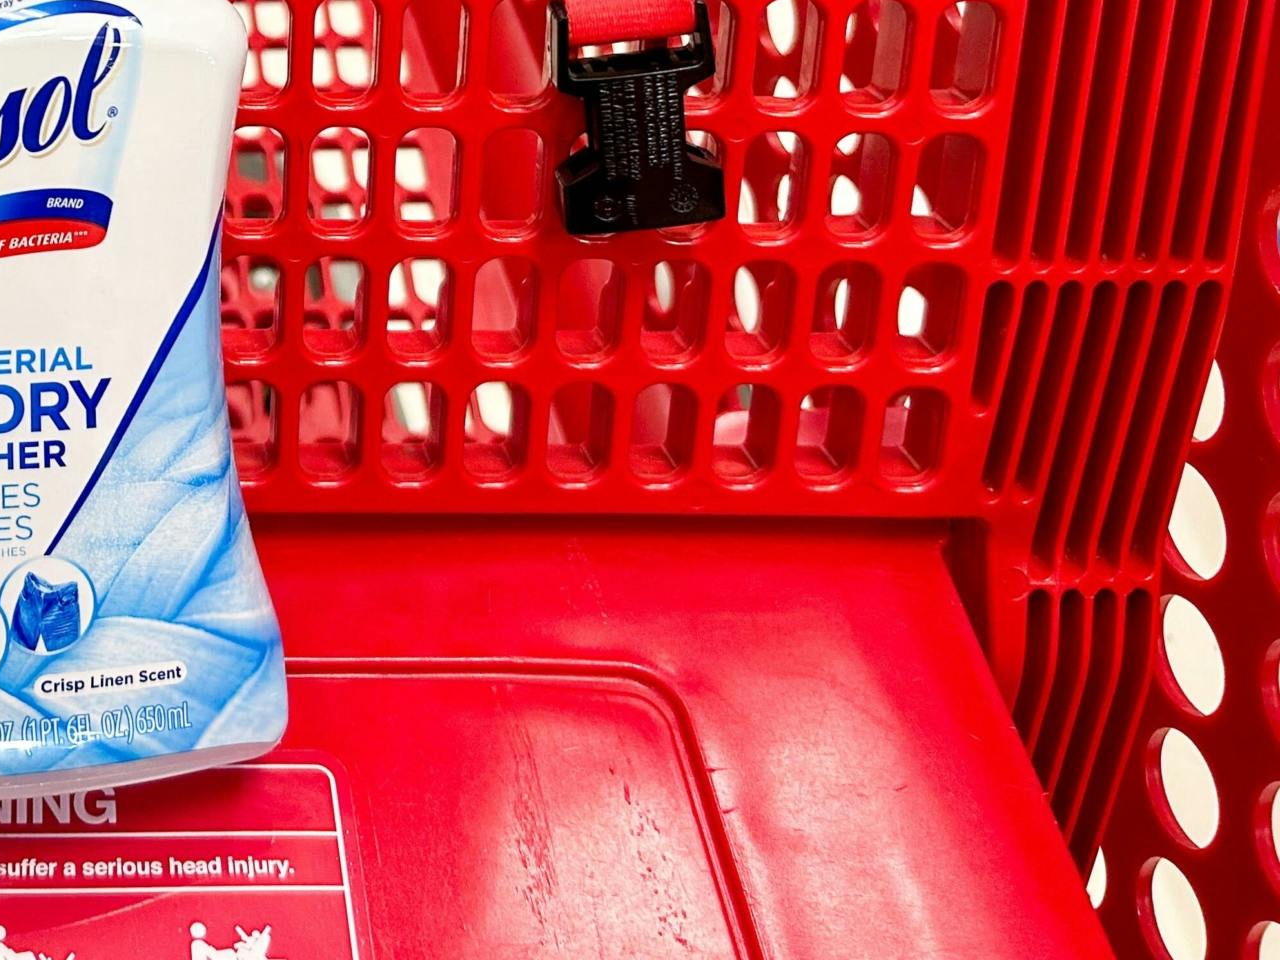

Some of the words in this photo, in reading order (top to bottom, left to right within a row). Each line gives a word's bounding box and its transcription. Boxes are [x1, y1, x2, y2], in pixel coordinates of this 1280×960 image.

[46, 197, 84, 209] BRAND
[41, 678, 85, 693] Crisp
[90, 674, 134, 689] Linen
[139, 666, 182, 684] Scent
[135, 704, 165, 734] 650
[166, 701, 192, 731] mL
[63, 861, 76, 876] a
[82, 857, 163, 877] serious
[169, 856, 221, 876] head
[228, 856, 295, 880] injury.
